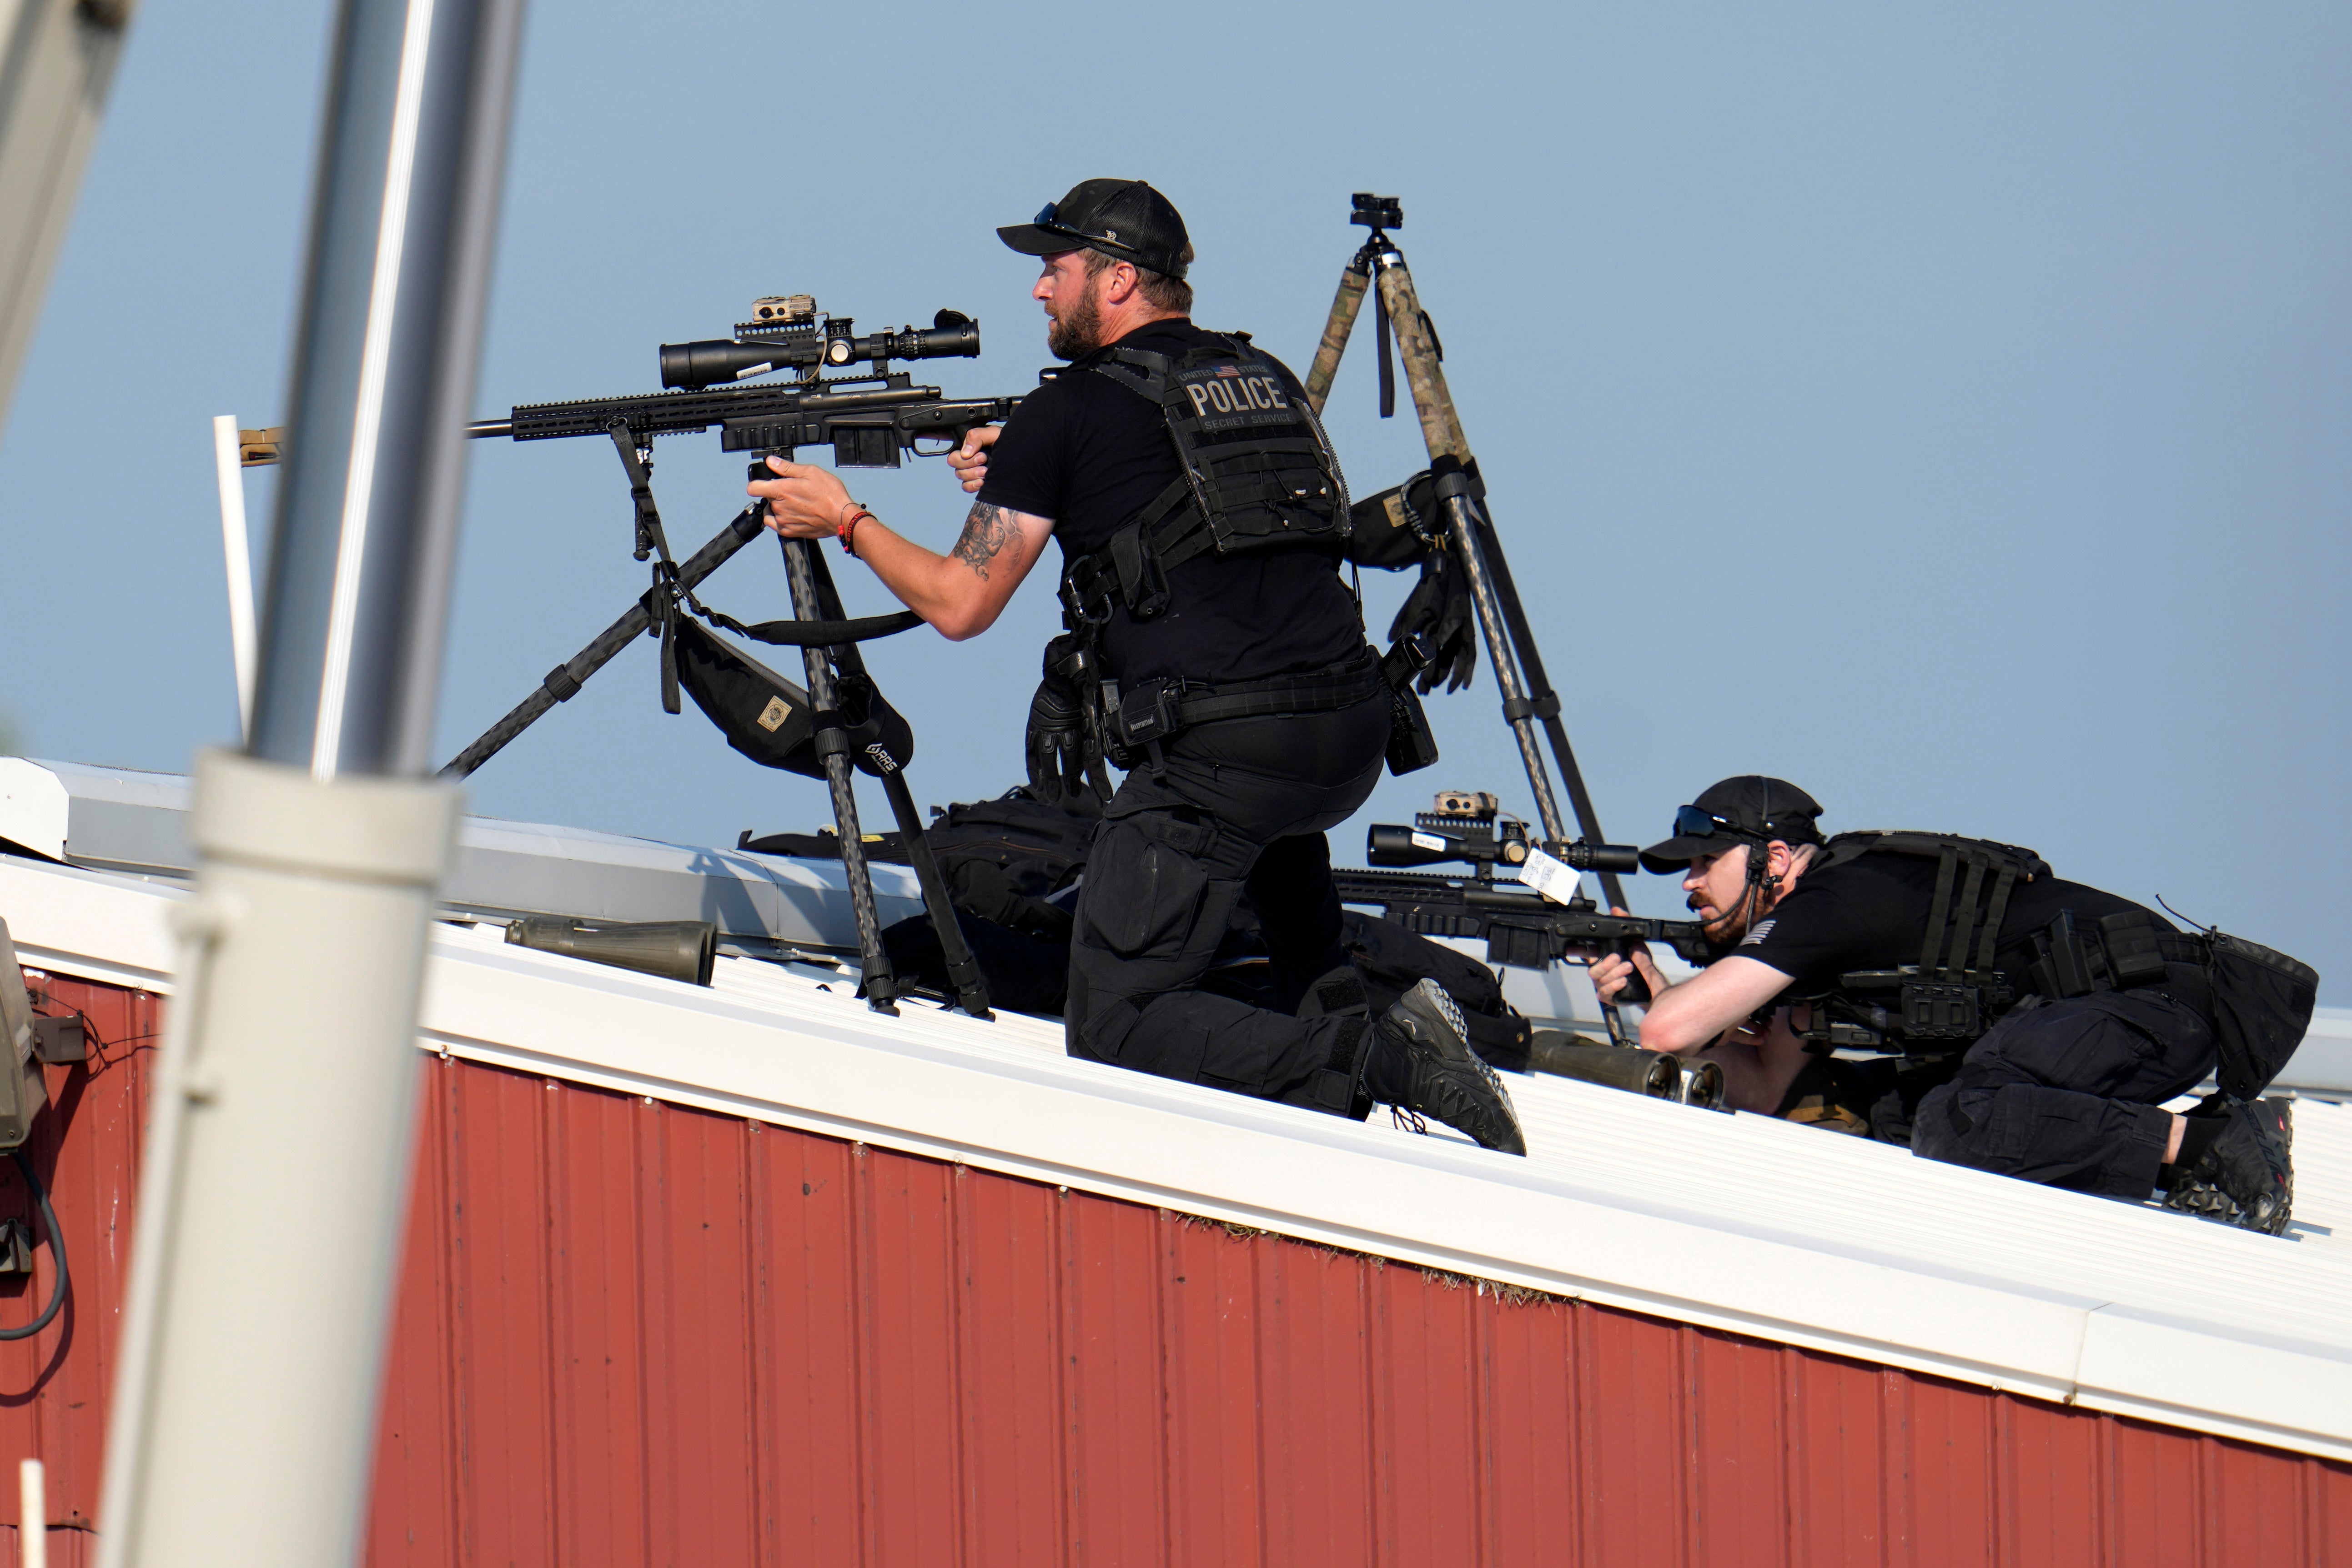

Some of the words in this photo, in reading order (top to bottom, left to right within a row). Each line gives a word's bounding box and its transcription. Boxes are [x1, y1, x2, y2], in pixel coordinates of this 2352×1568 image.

[1179, 369, 1215, 381] UNITED
[1186, 377, 1287, 416] POLICE
[1205, 416, 1244, 430] SECRET
[1251, 414, 1292, 424] SERVICE
[875, 750, 898, 771] RRS
